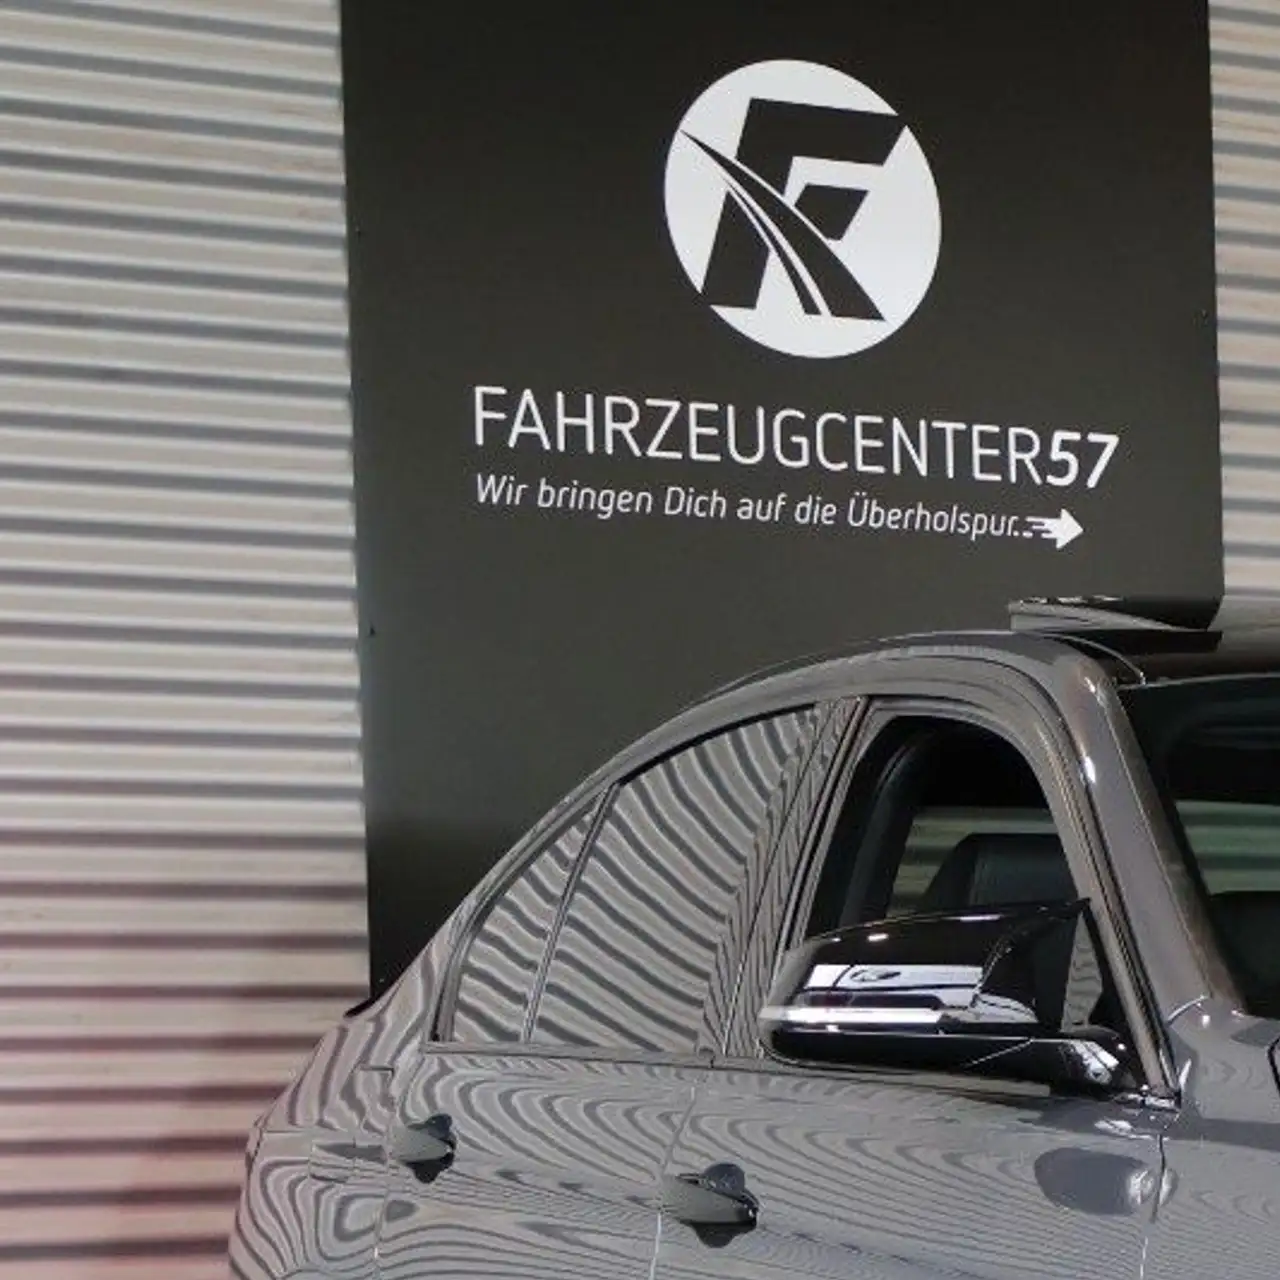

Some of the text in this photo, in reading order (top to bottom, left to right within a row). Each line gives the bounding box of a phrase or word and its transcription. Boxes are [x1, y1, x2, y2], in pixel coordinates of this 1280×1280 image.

[474, 386, 1119, 488] FAHRZEUGCENTER57
[477, 473, 528, 505] Wir
[537, 477, 652, 519] bringen
[664, 486, 727, 518] Dich
[736, 492, 787, 522] auf
[794, 495, 838, 525] die
